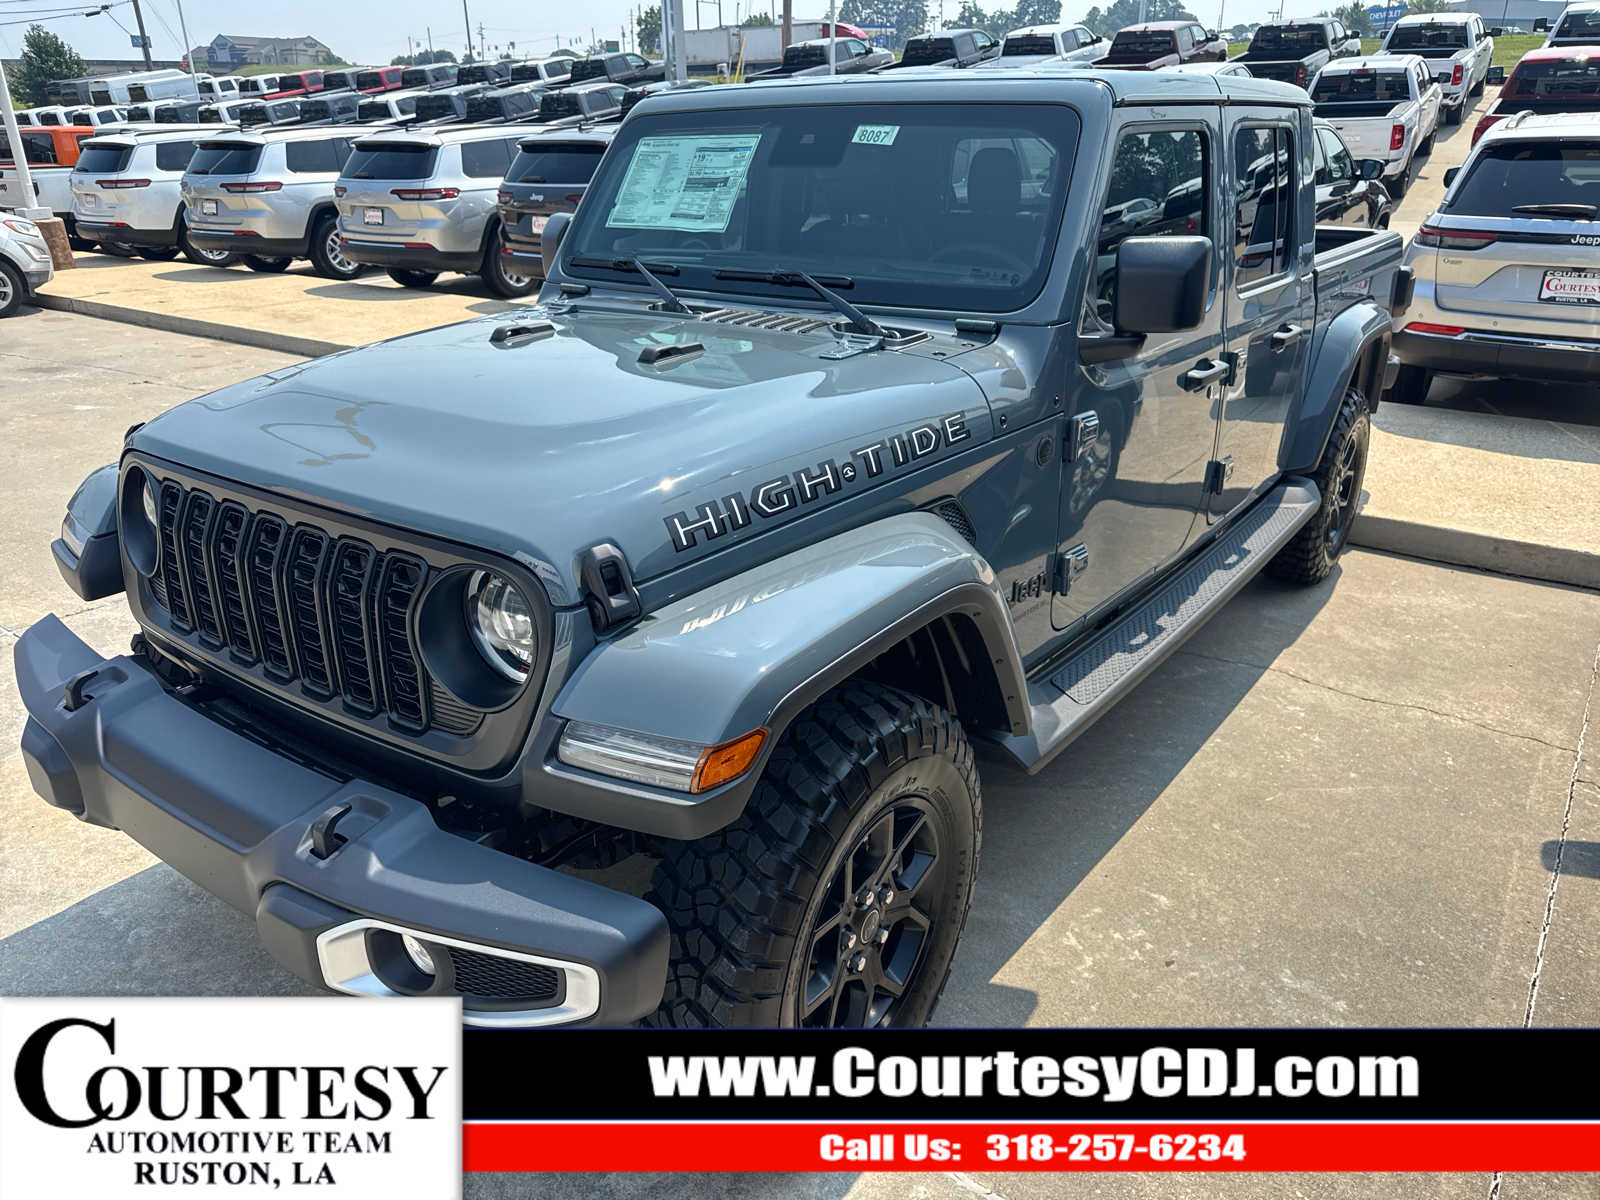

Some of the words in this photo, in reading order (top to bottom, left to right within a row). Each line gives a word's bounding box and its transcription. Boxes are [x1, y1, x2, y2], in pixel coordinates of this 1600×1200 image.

[859, 129, 889, 143] 8087
[1570, 234, 1600, 246] Jeep
[663, 458, 843, 553] HIGH
[850, 410, 972, 479] TIDE
